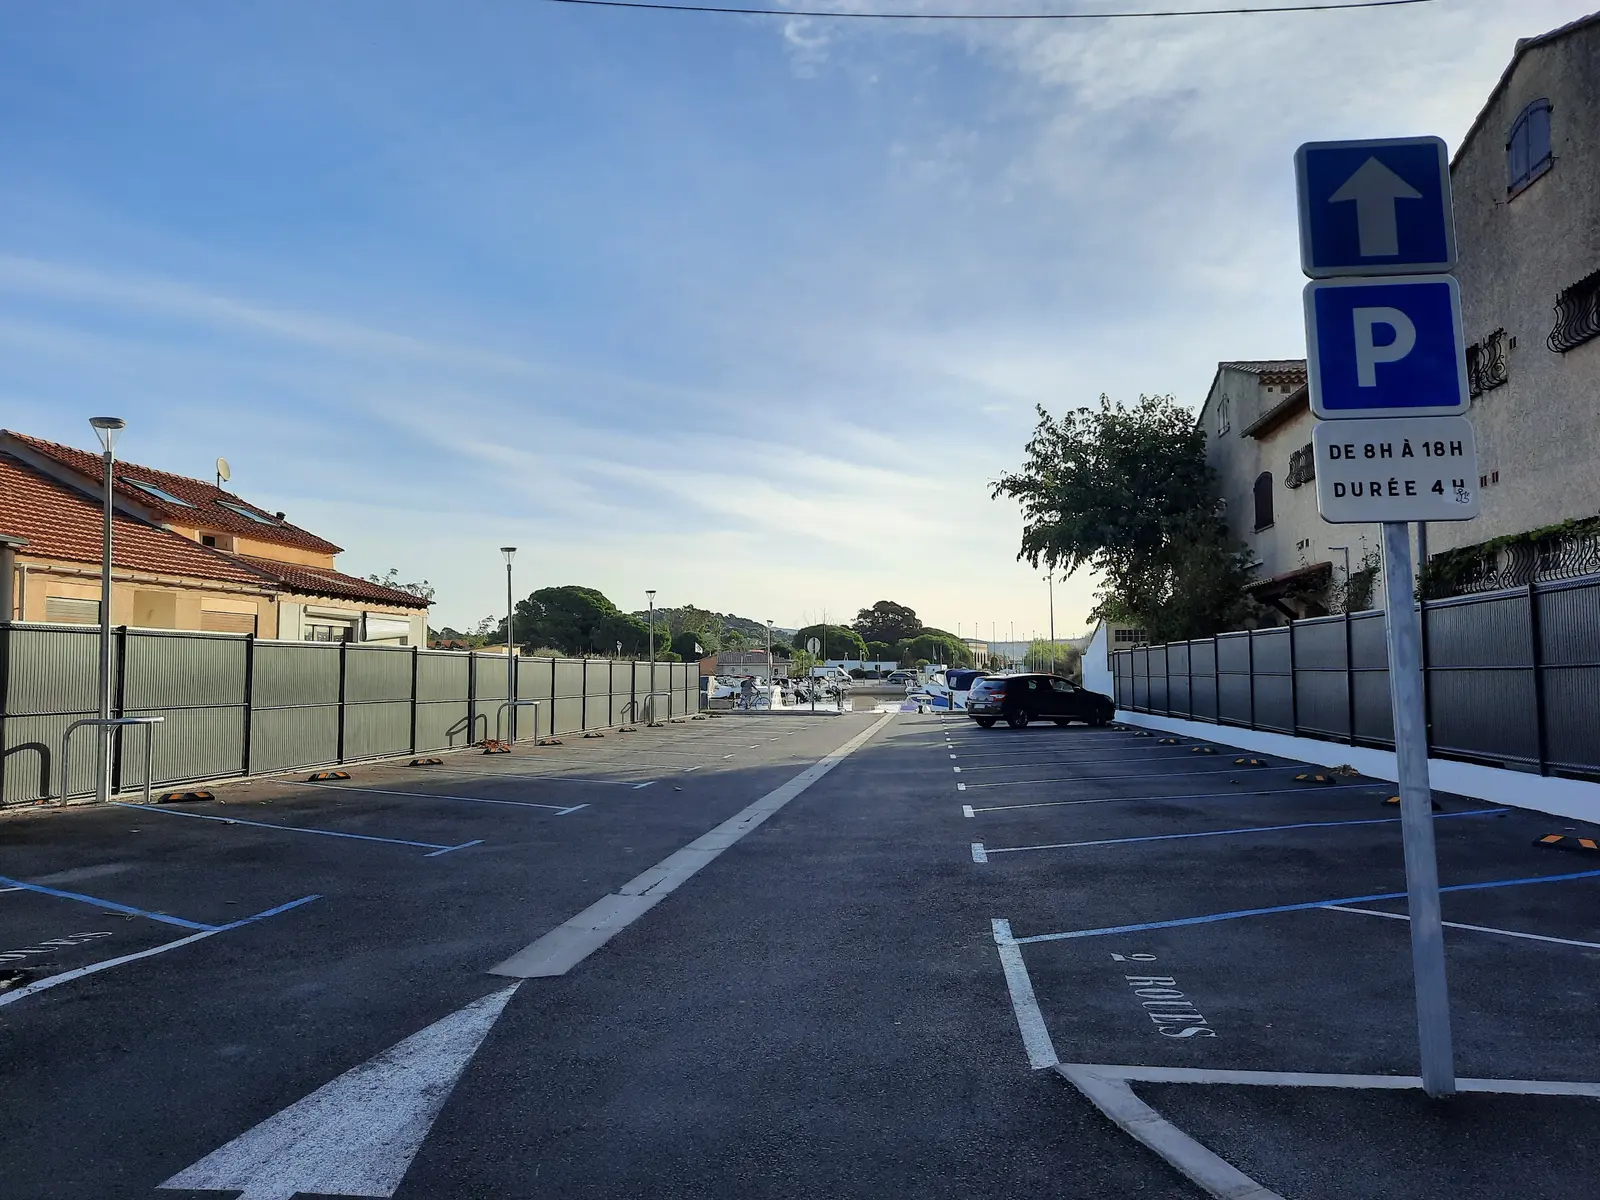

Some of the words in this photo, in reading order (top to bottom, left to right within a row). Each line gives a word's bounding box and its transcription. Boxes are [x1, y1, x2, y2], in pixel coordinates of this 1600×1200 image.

[1352, 306, 1417, 388] P
[1329, 444, 1356, 460] DE
[1364, 442, 1393, 459] 8H
[1401, 438, 1414, 458] À
[1422, 440, 1463, 457] 18H
[1333, 477, 1418, 498] DURÉE
[1125, 974, 1219, 1038] ROUES
